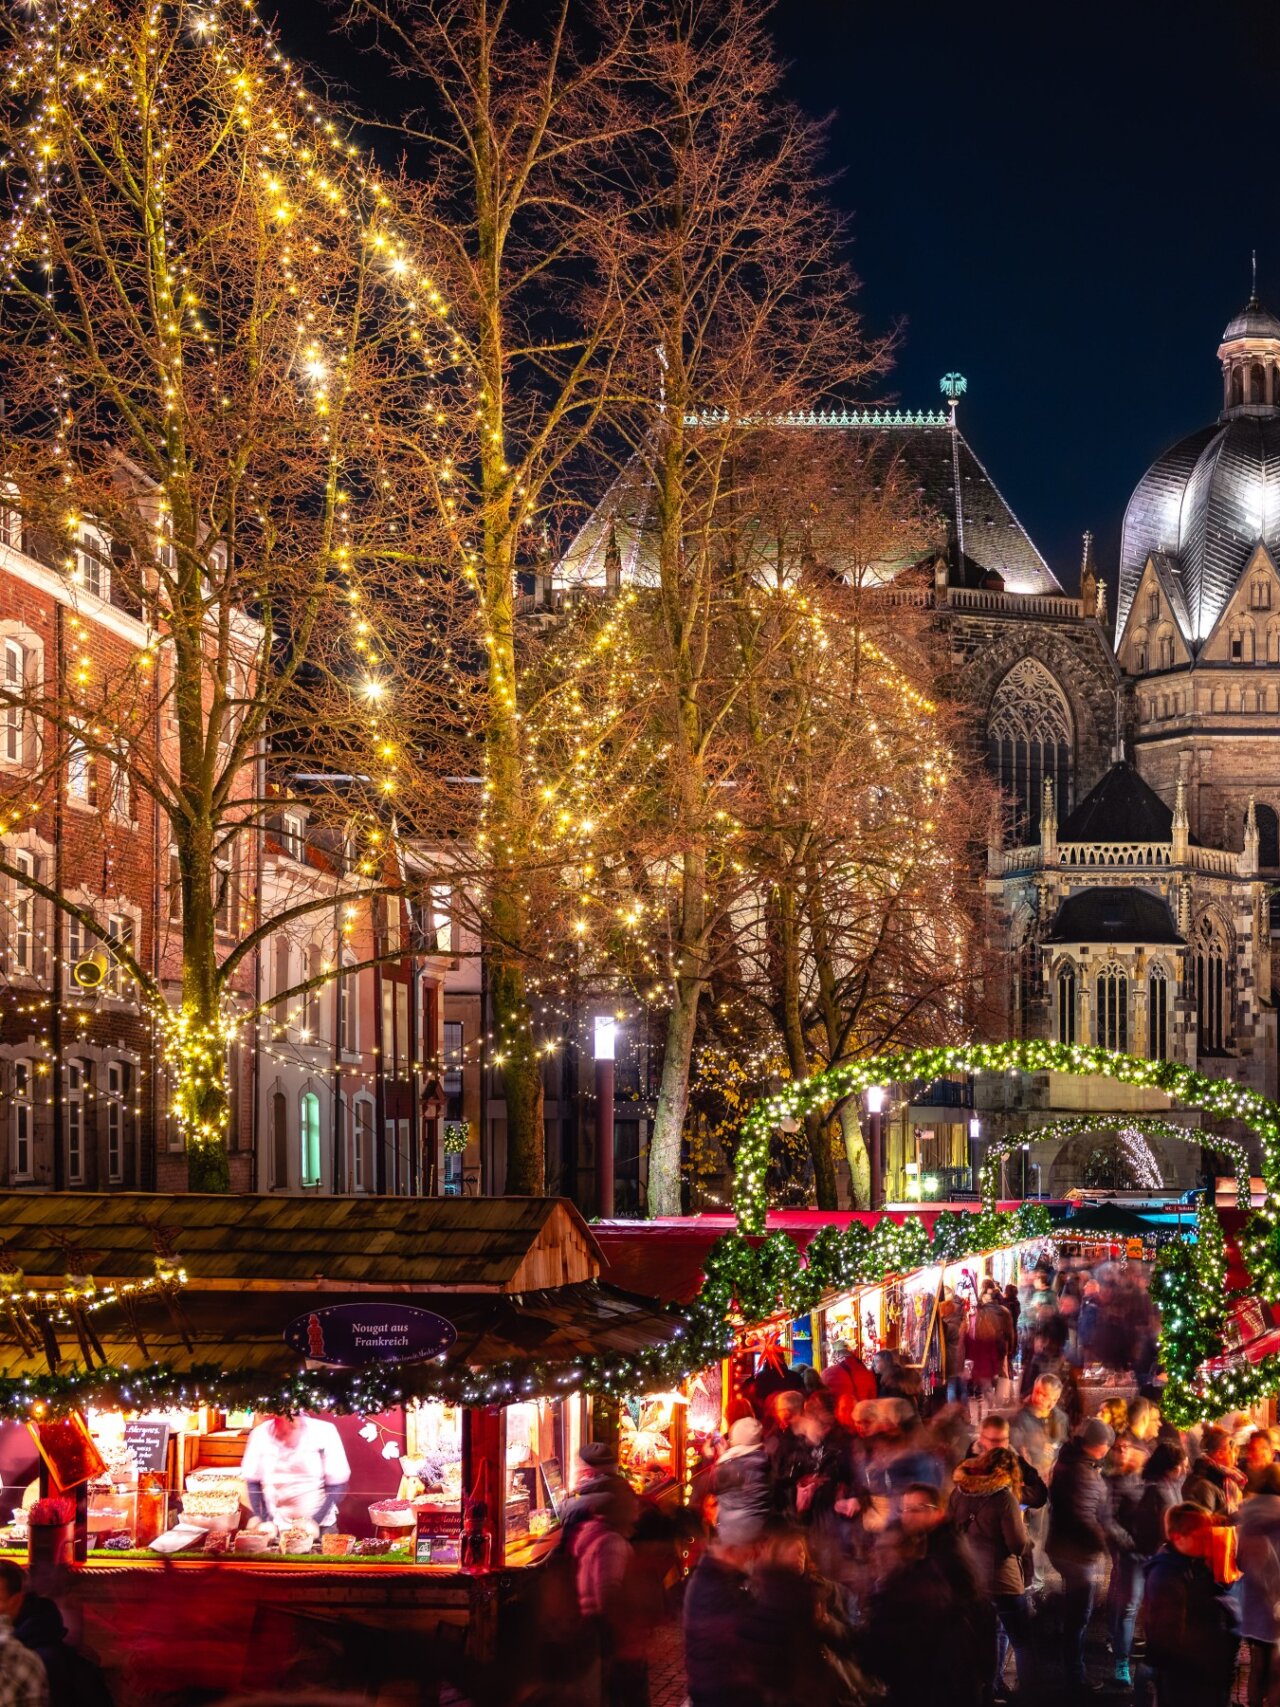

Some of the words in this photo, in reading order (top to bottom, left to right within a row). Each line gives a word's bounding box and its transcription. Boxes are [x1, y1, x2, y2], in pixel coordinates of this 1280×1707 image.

[352, 1323, 389, 1335] Nougat
[391, 1324, 409, 1333] aus
[354, 1337, 409, 1347] Frankreich
